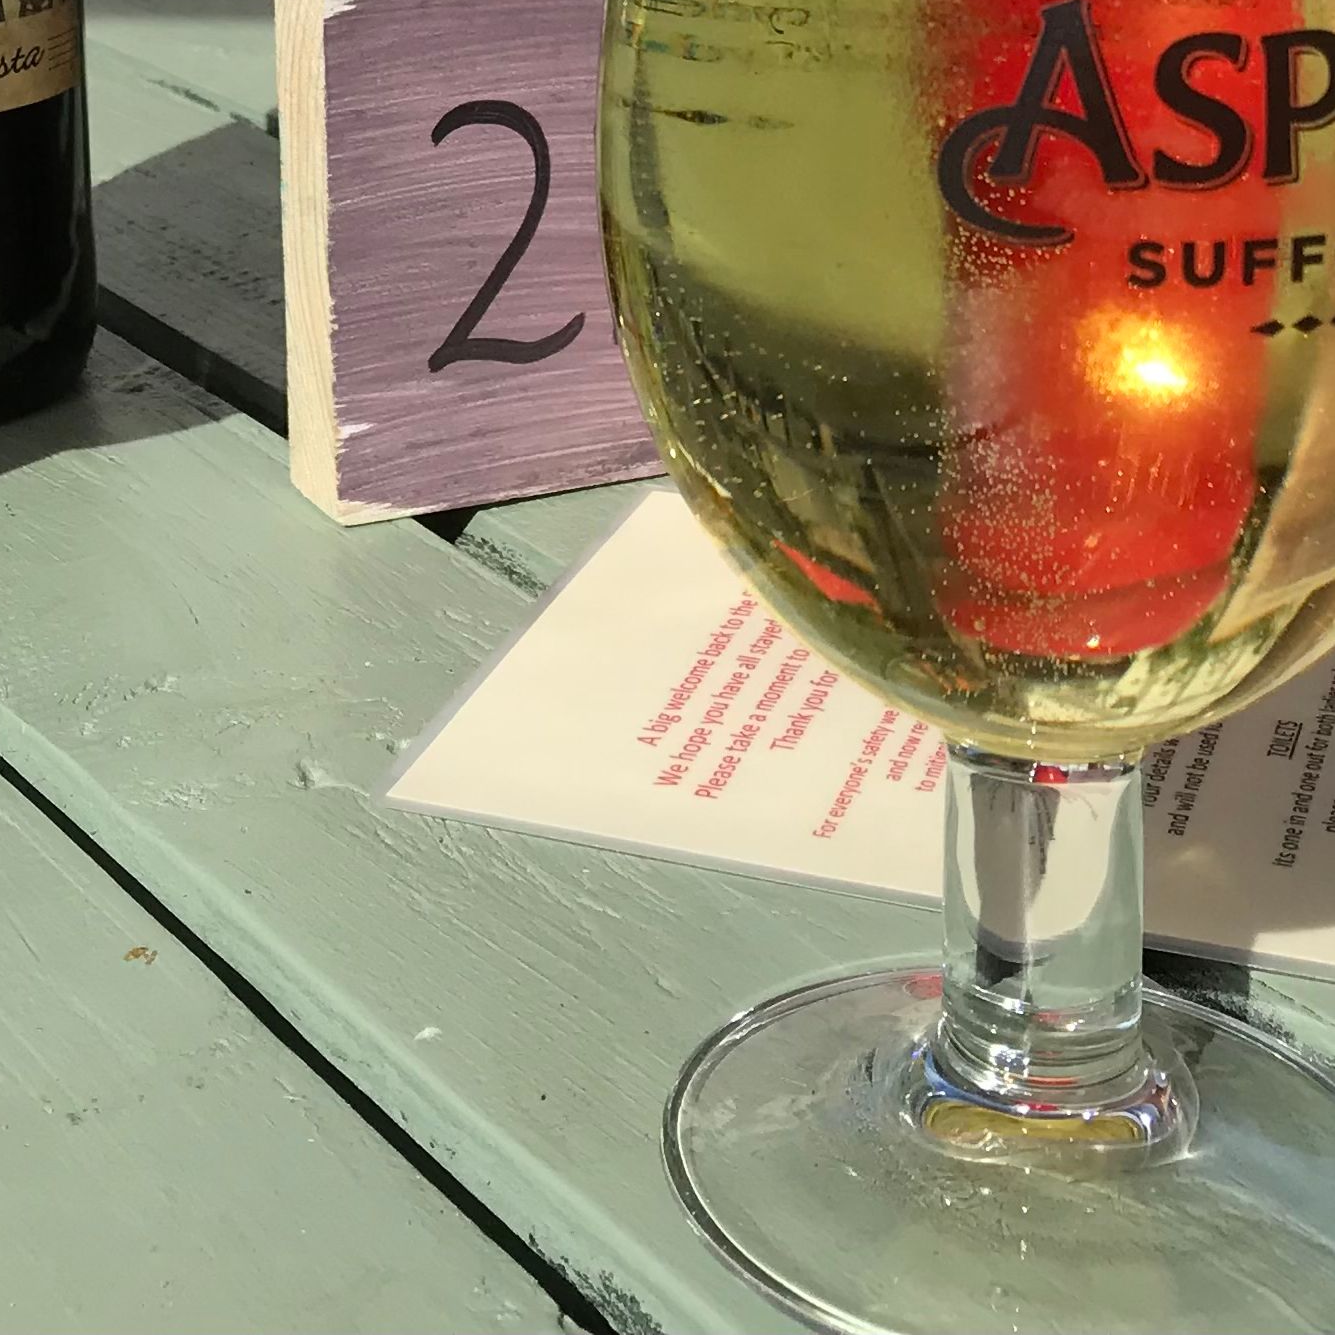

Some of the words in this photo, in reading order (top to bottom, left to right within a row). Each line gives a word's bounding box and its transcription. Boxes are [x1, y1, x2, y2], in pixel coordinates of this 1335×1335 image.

[428, 99, 586, 373] 2
[1127, 235, 1326, 289] SUFF
[729, 599, 758, 617] the
[720, 617, 744, 631] to
[696, 632, 734, 658] back
[785, 648, 811, 661] to
[736, 655, 761, 670] all
[664, 658, 715, 711] welcome
[711, 671, 750, 700] have
[755, 661, 803, 713] moment
[809, 669, 840, 688] for
[800, 686, 830, 713] you
[642, 712, 682, 733] big
[701, 700, 730, 726] you
[749, 713, 767, 723] a
[637, 734, 662, 747] A
[725, 723, 761, 753] take
[769, 712, 814, 751] Thank
[1266, 719, 1298, 758] TOILETS
[669, 726, 713, 762] hope
[886, 759, 909, 782] and
[898, 734, 921, 760] now
[1186, 757, 1210, 772] be
[1306, 752, 1326, 772] out
[653, 763, 689, 786] We
[694, 754, 742, 799] Please
[812, 819, 839, 839] For
[828, 756, 874, 819] everyone's
[862, 724, 896, 757] safety
[880, 709, 900, 725] we
[1184, 771, 1205, 792] not
[1299, 771, 1320, 792] one
[915, 779, 935, 793] to
[1175, 789, 1197, 812] will
[1291, 792, 1313, 815] and
[1167, 812, 1190, 837] and
[1284, 815, 1307, 827] in
[1282, 827, 1304, 851] one
